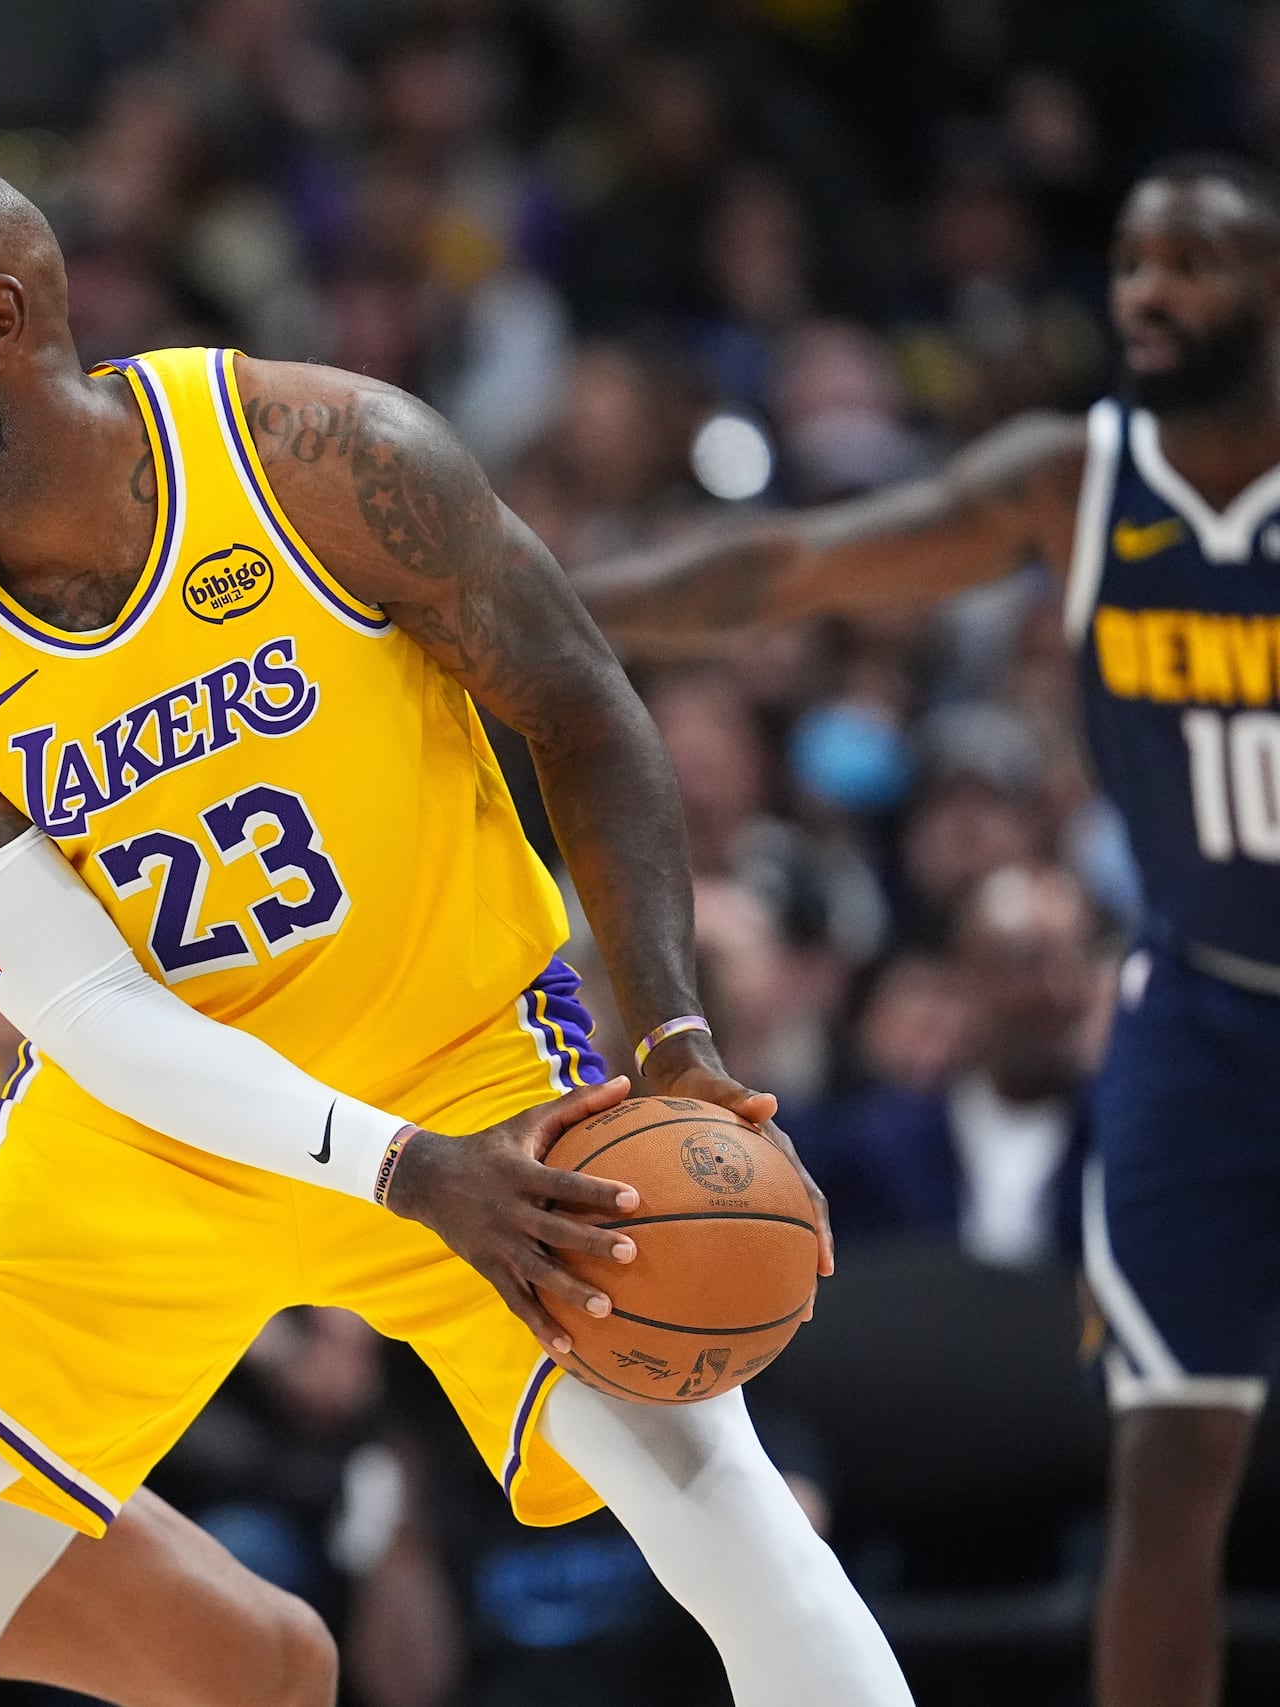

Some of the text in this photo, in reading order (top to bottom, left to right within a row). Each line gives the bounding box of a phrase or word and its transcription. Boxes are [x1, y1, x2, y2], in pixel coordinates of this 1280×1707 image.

[246, 396, 357, 463] 1984
[188, 561, 266, 605] bibigo
[210, 589, 244, 610] 비비고
[8, 635, 320, 839] LAKERS
[1181, 708, 1280, 863] 10
[93, 782, 352, 985] 23
